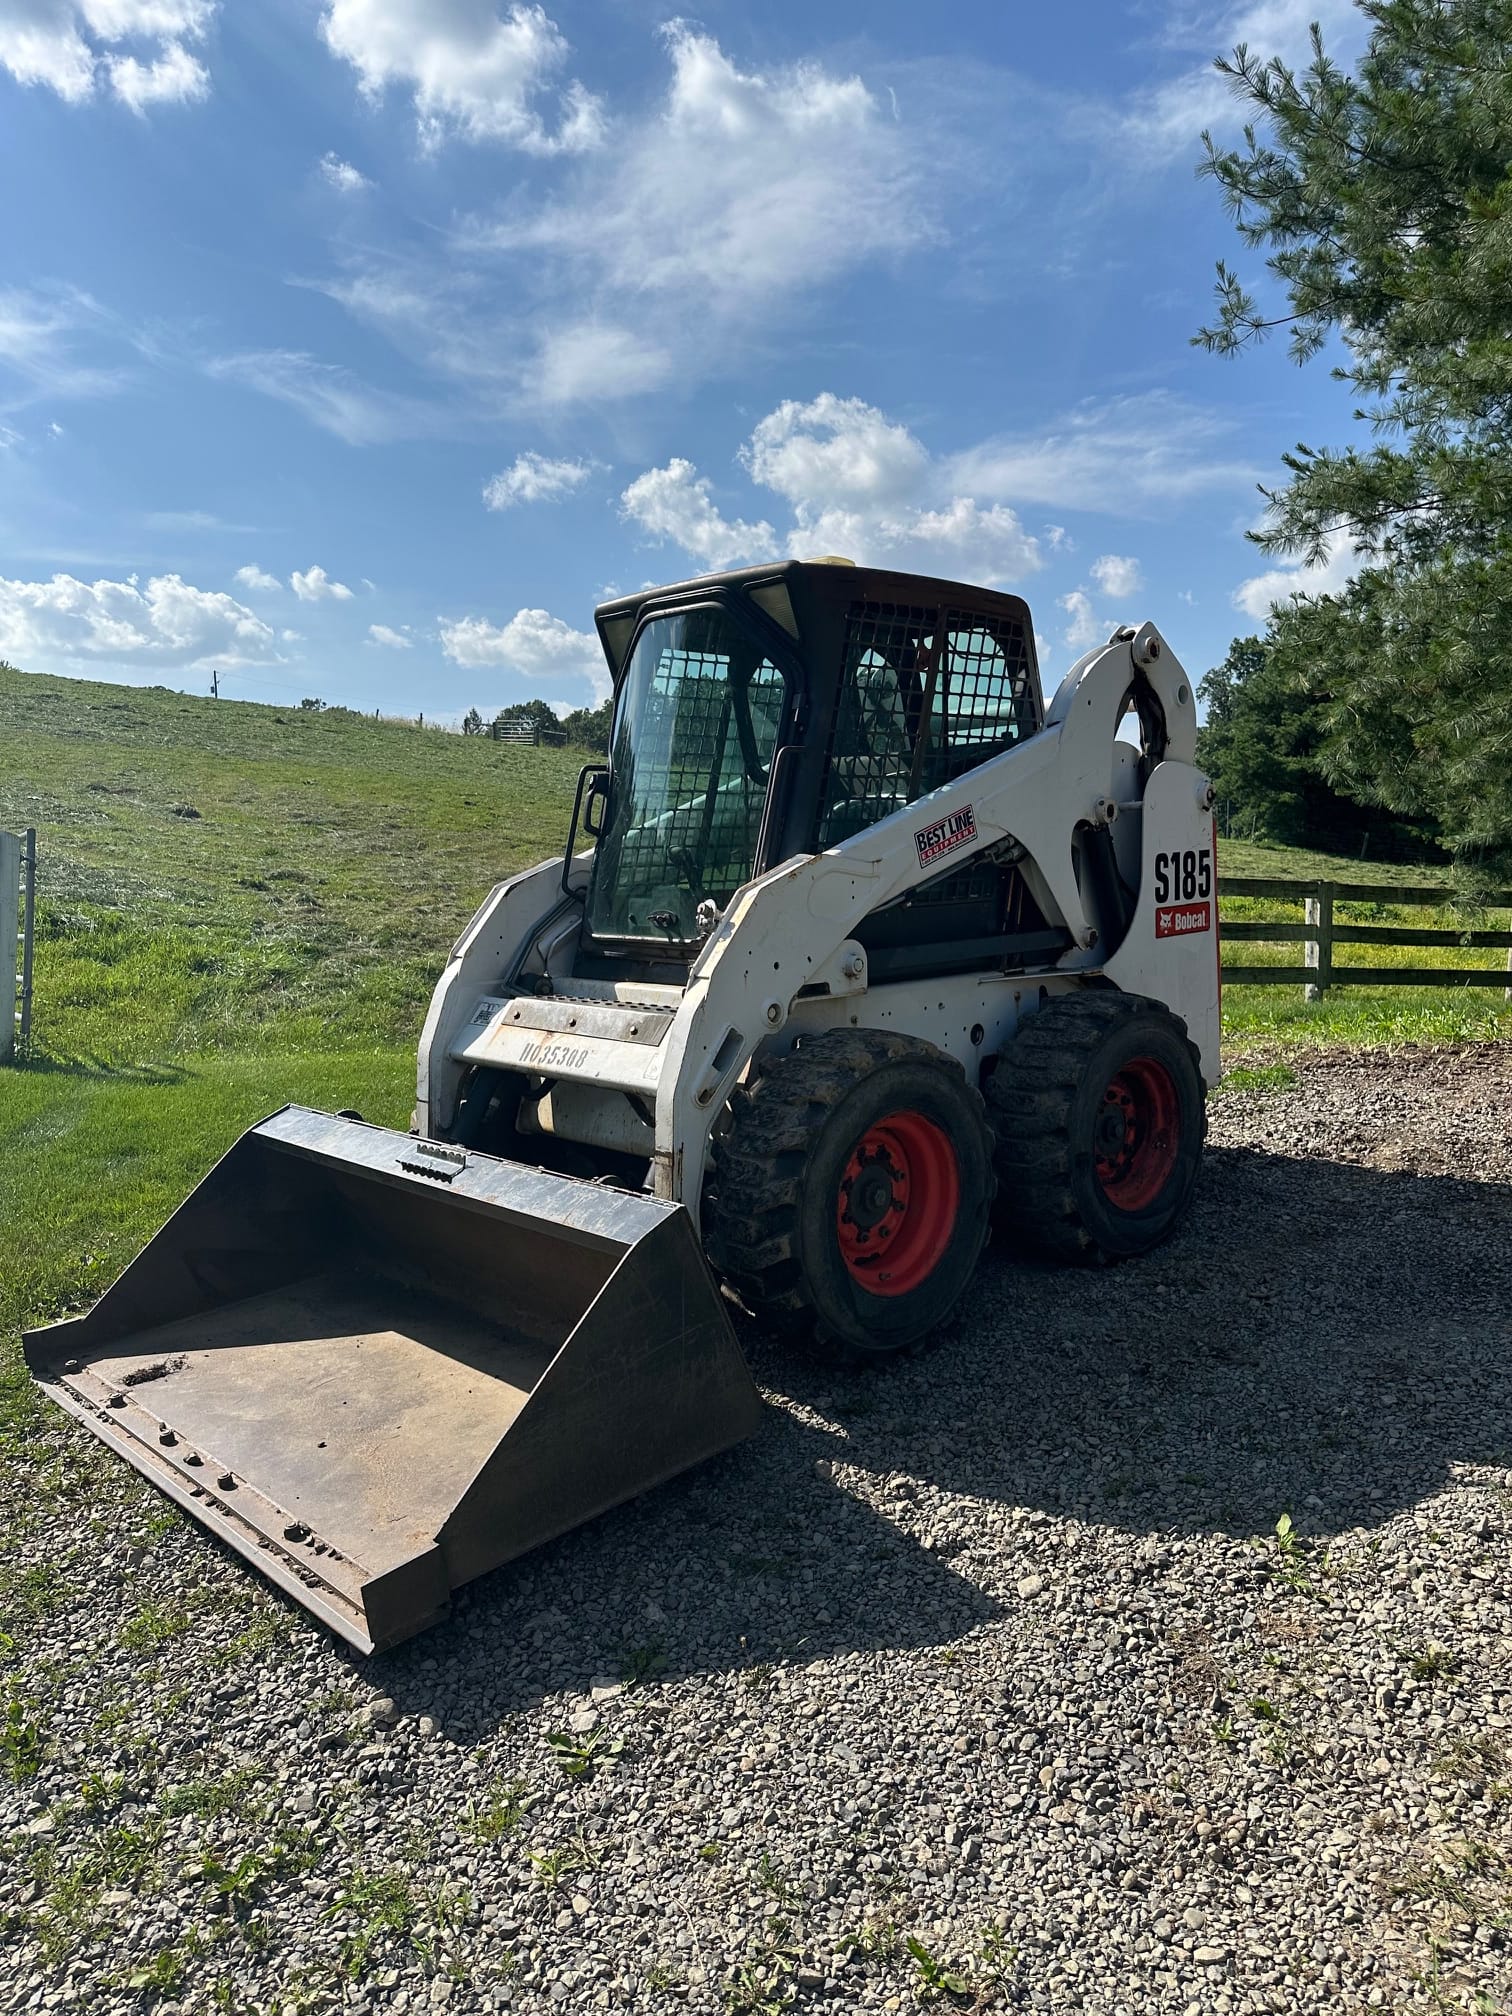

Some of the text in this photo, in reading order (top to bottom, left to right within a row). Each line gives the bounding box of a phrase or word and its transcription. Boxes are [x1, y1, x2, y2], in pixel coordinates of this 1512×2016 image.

[916, 823, 947, 853] BEST
[947, 809, 974, 836] LINE
[921, 826, 974, 860] EQUIPMENT
[1155, 849, 1211, 904] S185
[1175, 910, 1206, 931] Bobcat
